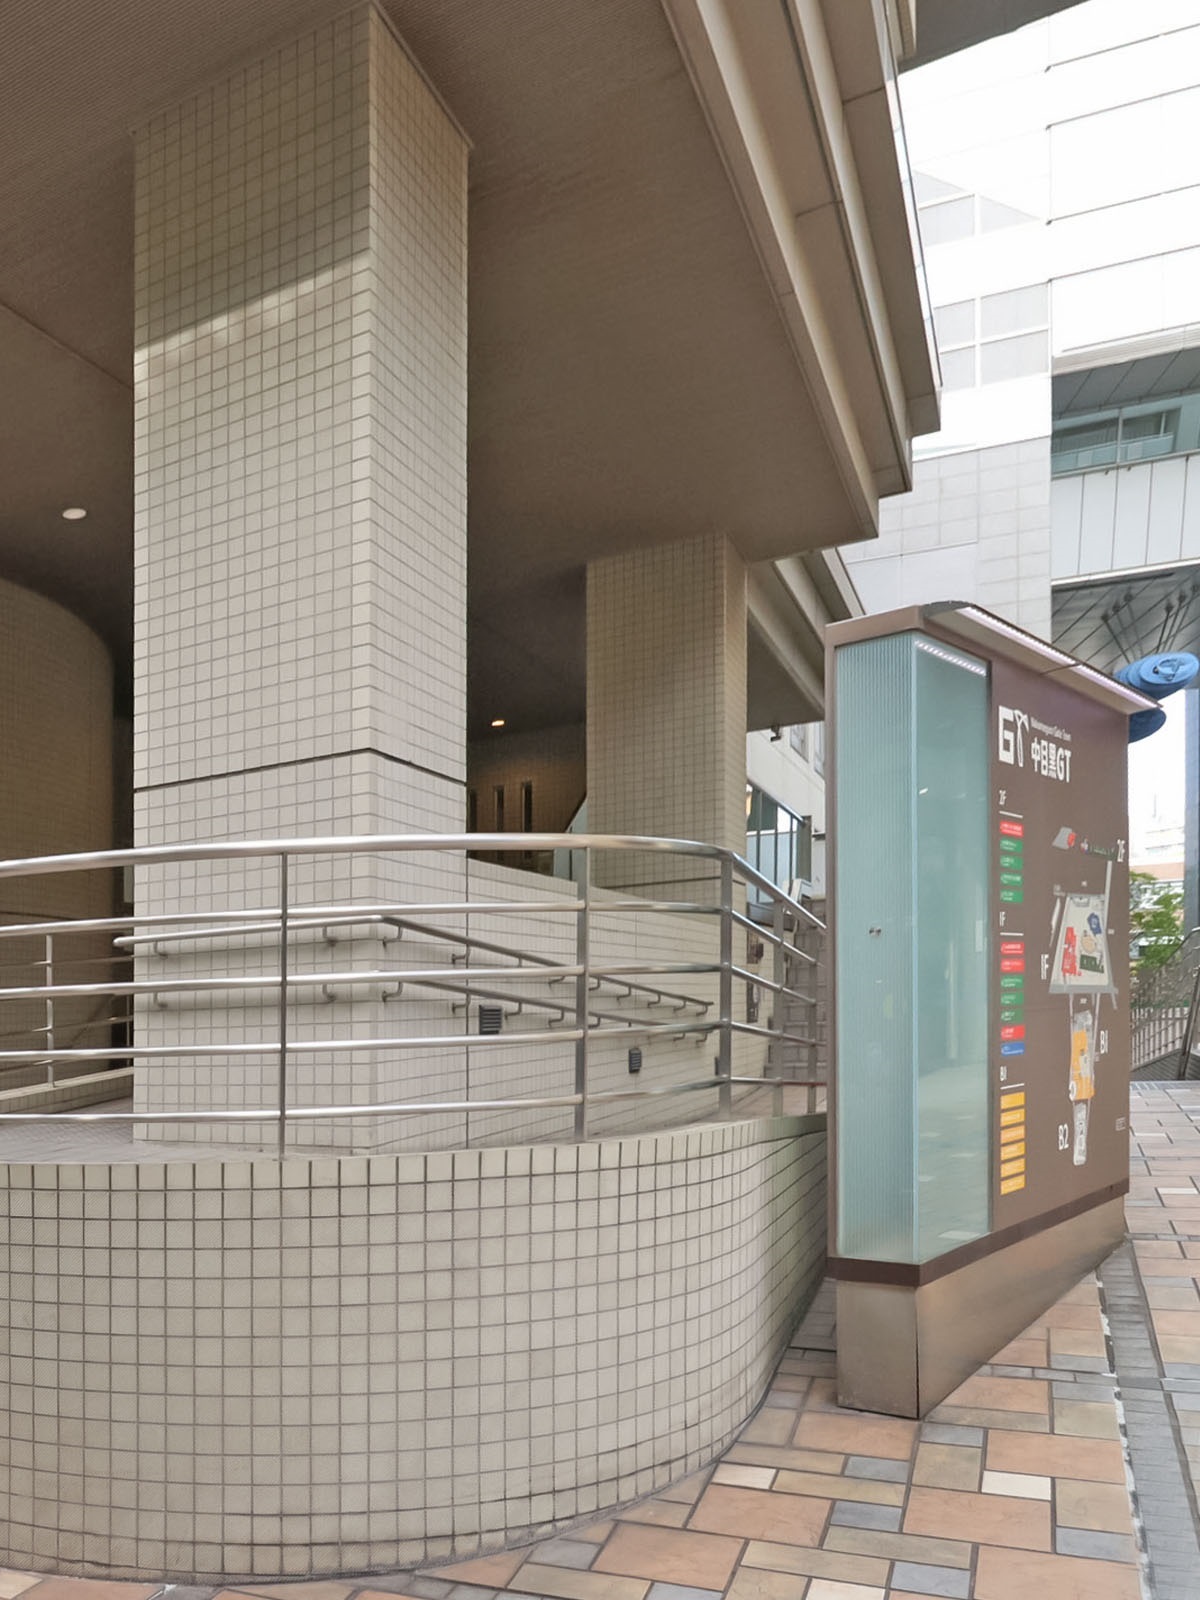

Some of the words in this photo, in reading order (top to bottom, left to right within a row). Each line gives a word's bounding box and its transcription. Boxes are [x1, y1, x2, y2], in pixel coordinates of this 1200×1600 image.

[1031, 736, 1072, 783] 中目黒GT
[1058, 1124, 1069, 1150] B2
